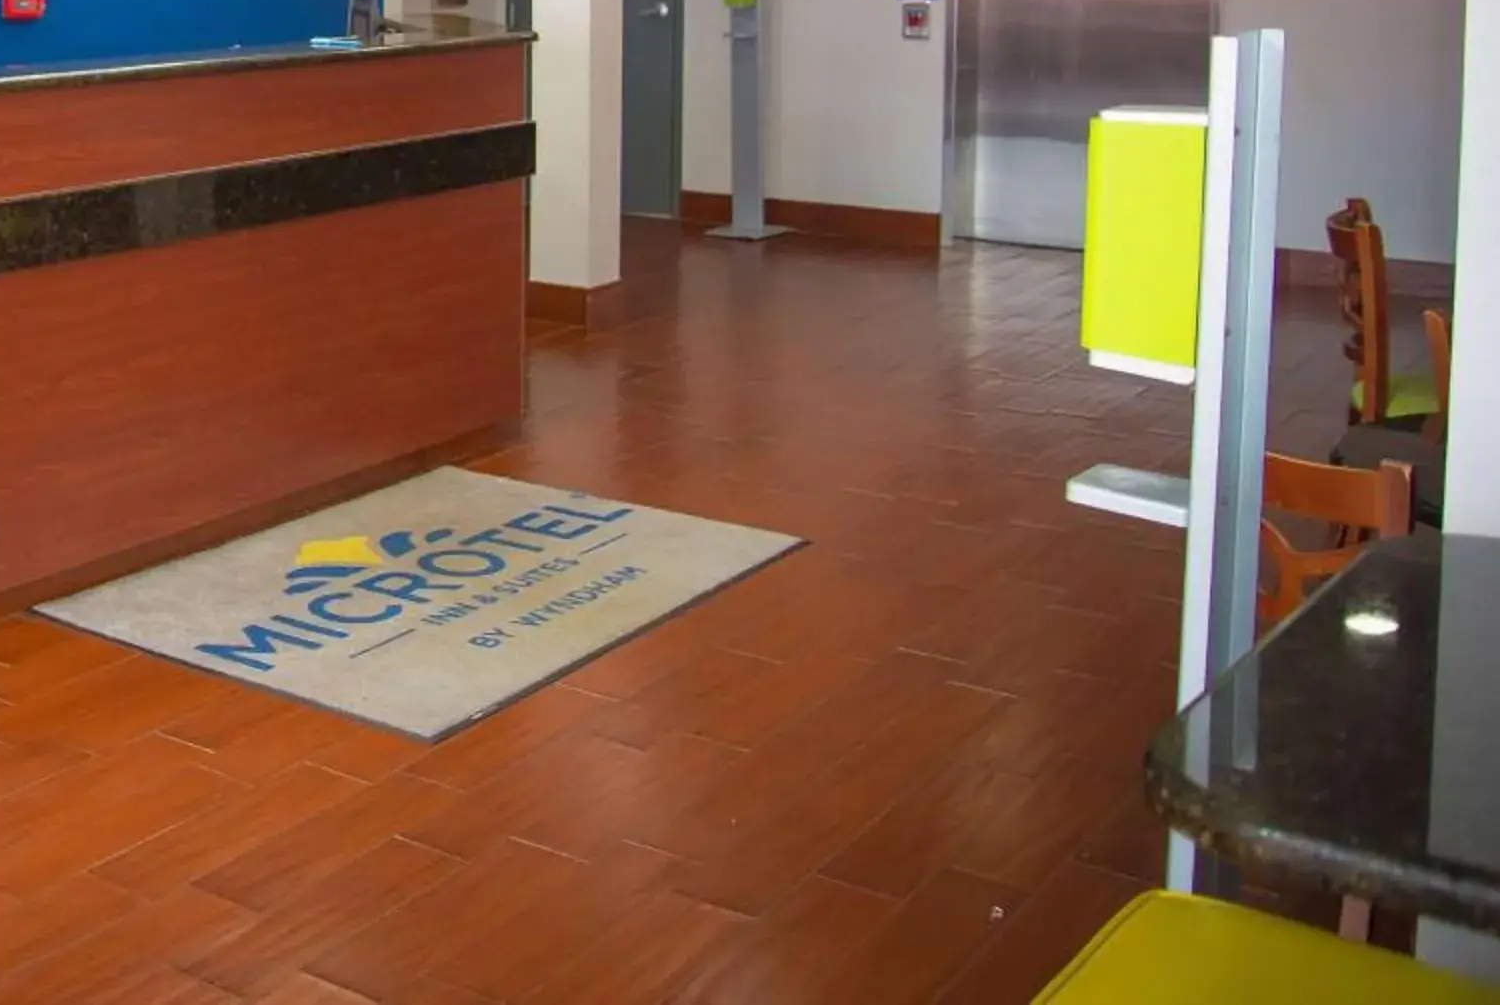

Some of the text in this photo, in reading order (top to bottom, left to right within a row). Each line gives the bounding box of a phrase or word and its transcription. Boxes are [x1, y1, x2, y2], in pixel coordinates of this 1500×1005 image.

[194, 505, 633, 672] MICROTEL
[421, 556, 581, 626] INN & SUITES
[468, 565, 648, 648] BY WYNDHAM
